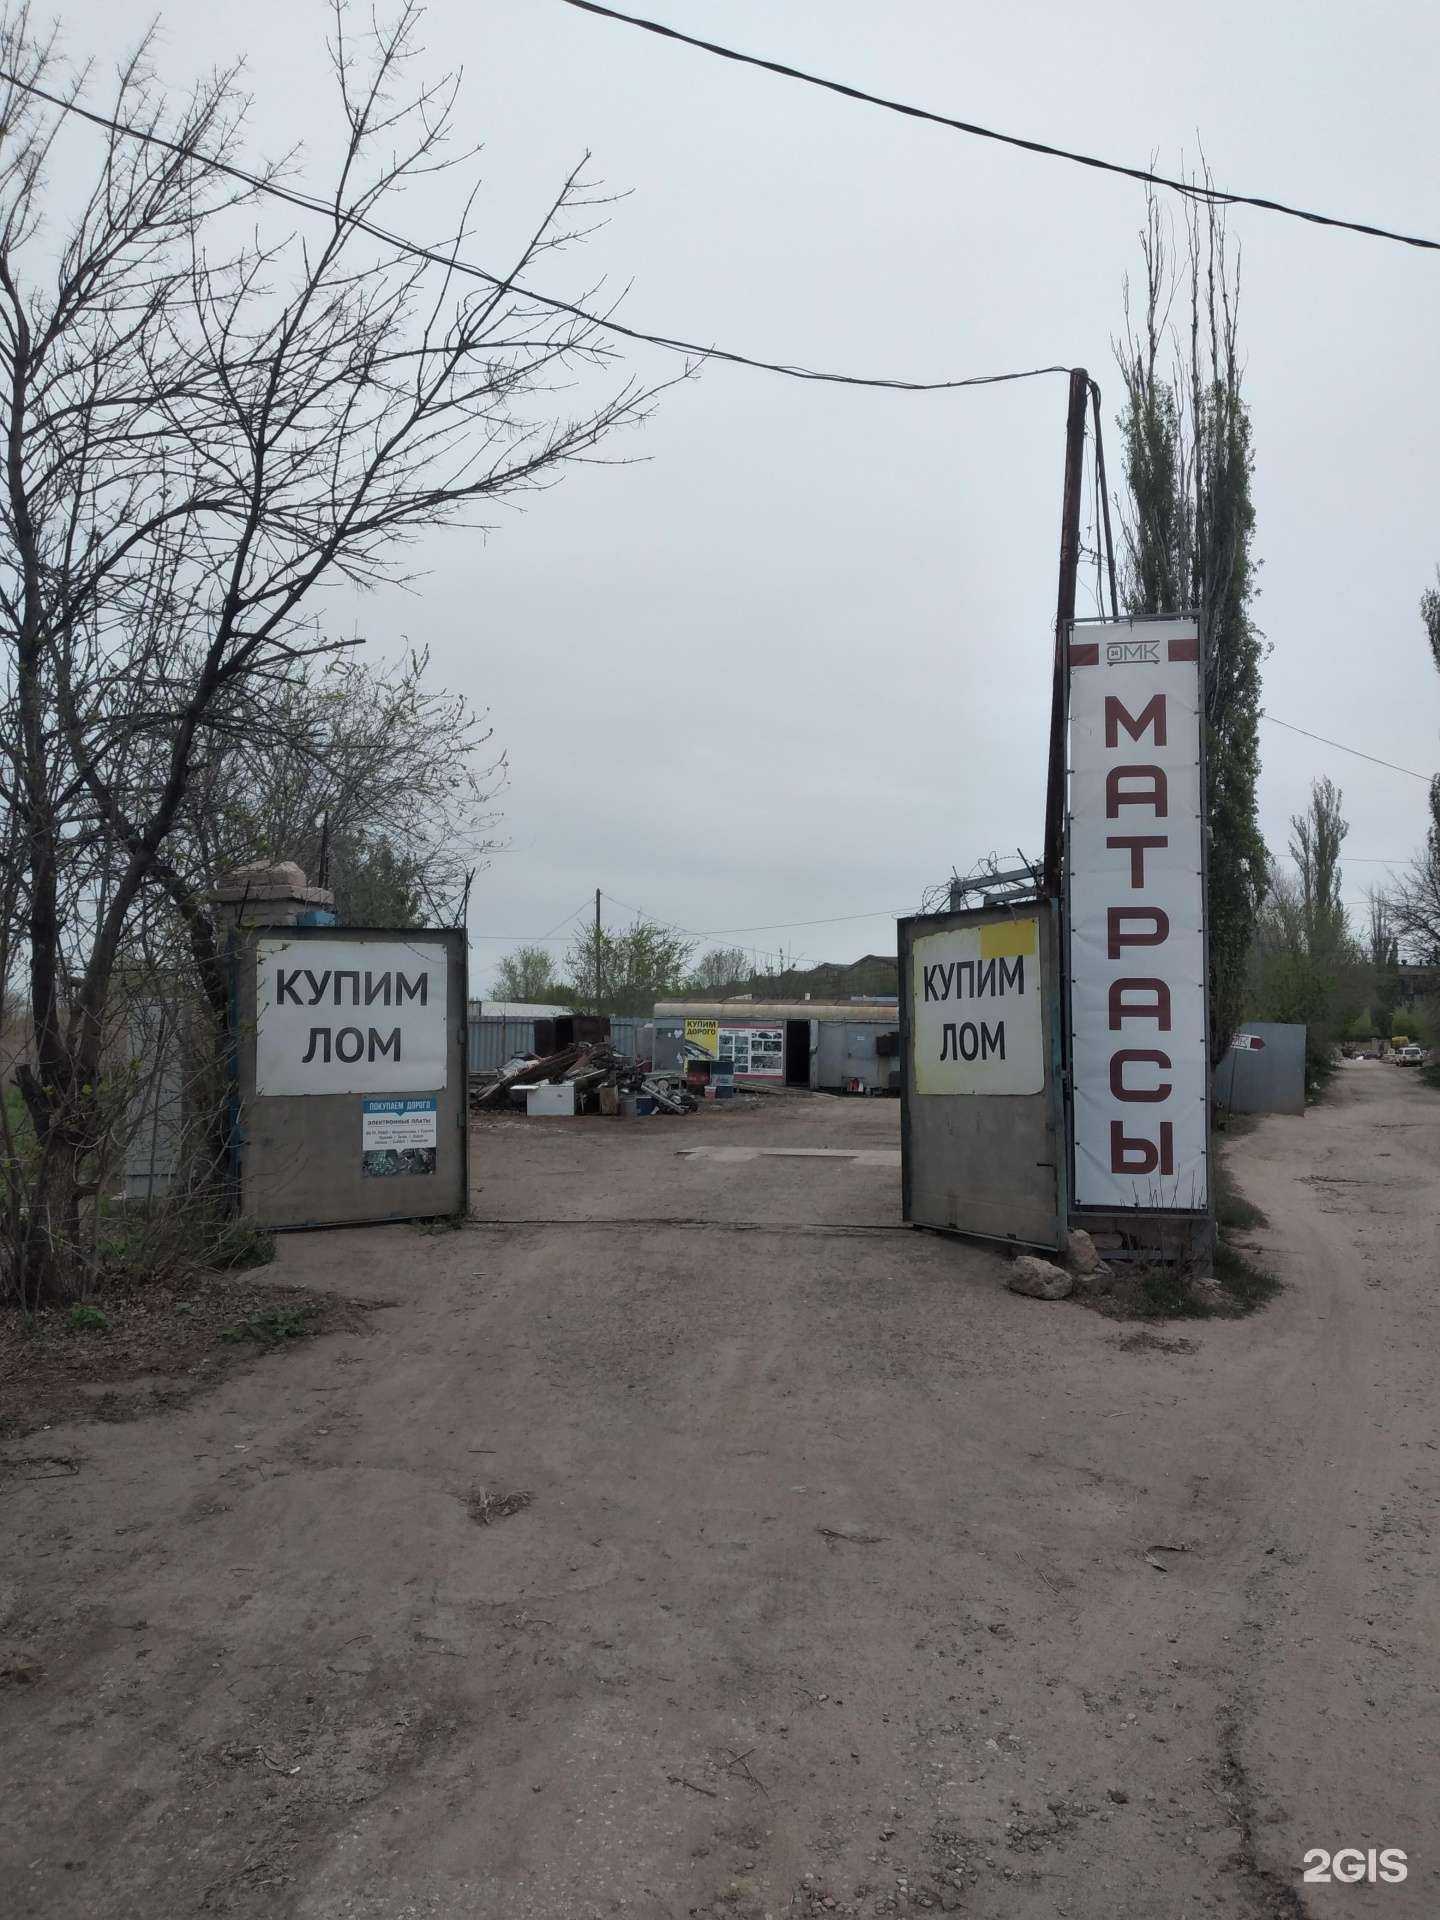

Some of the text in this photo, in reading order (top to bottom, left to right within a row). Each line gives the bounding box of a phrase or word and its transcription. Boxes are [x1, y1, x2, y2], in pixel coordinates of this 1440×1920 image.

[1104, 694, 1174, 1176] МАТРАСЫ
[276, 969, 428, 1006] КУПИМ
[924, 955, 1025, 1002] КУПИМ
[687, 1020, 716, 1028] КУПИМ
[940, 1021, 1006, 1061] ЛОМ
[302, 1027, 401, 1063] ЛОМ
[369, 1101, 404, 1111] ПОКУПАЕМ
